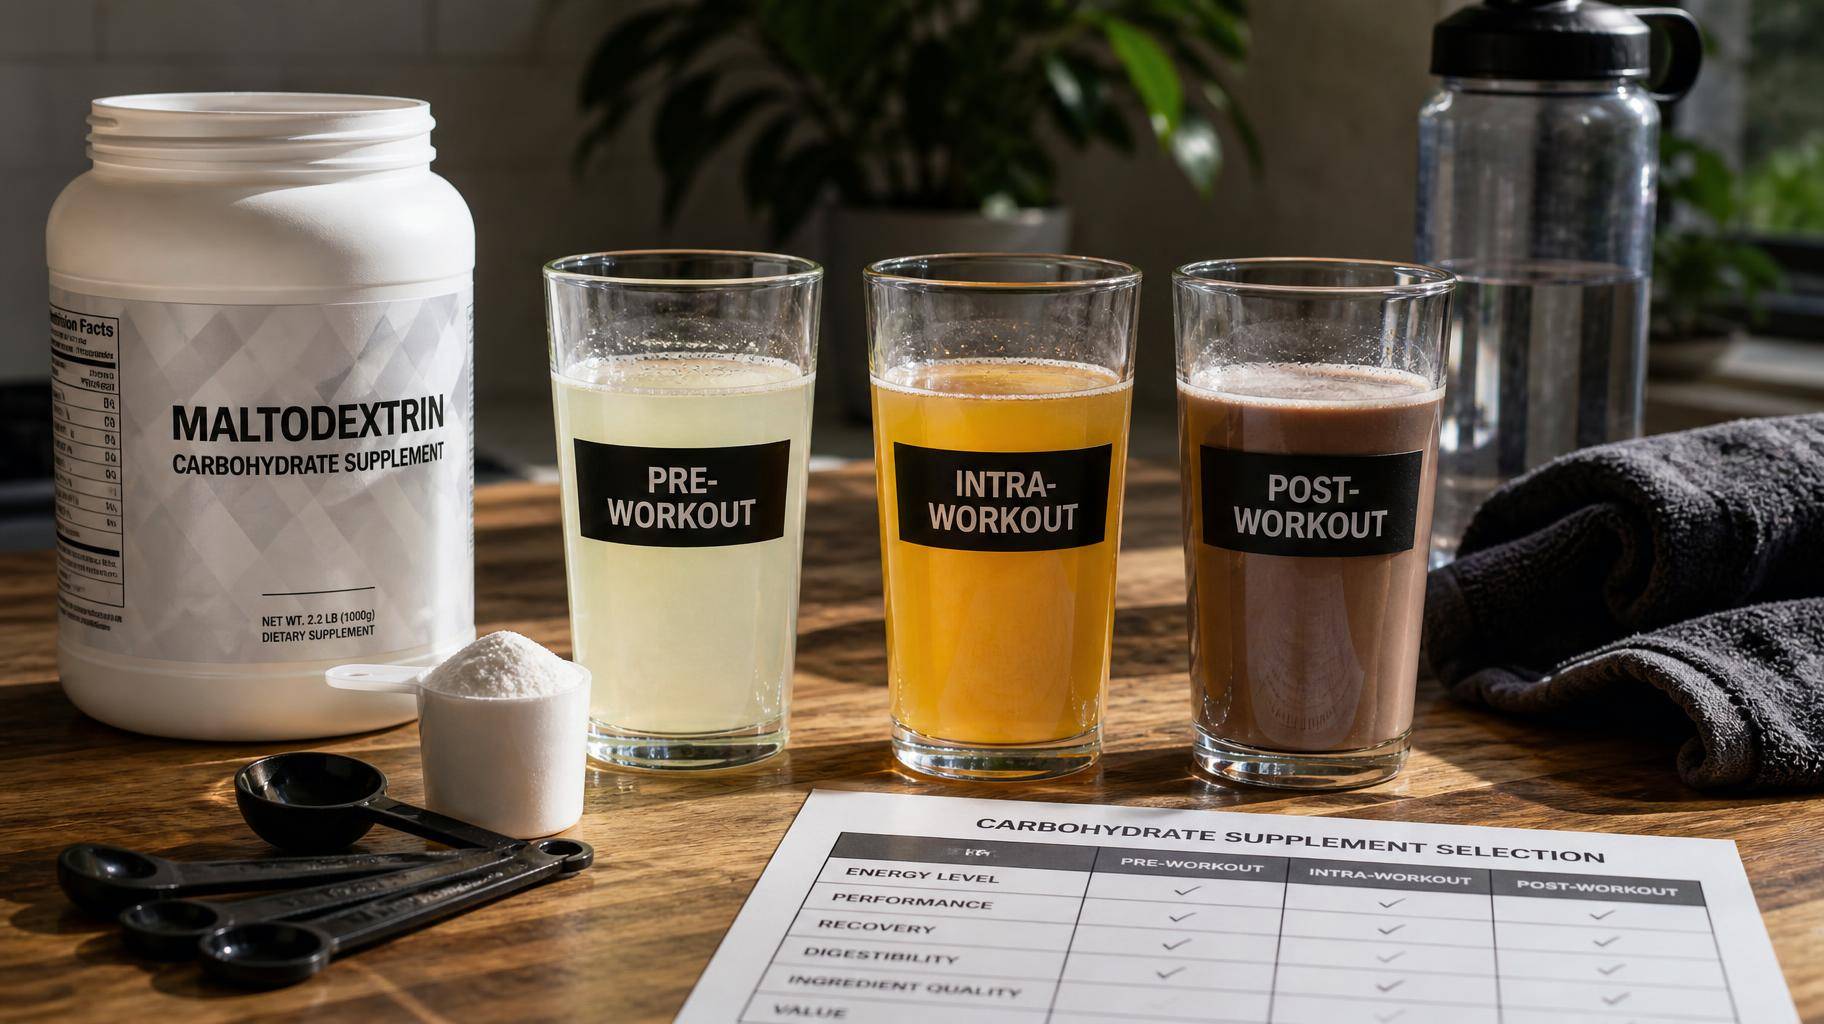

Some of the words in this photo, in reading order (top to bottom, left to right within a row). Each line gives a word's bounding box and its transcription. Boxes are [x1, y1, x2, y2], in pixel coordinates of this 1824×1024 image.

[80, 318, 114, 338] Facts
[172, 393, 444, 442] MALTODEXTRIN
[172, 454, 339, 476] CARBOHYDRATE
[344, 441, 444, 472] SUPPLEMENT
[647, 466, 718, 494] PRE-
[956, 469, 1057, 498] INTRA-
[1268, 474, 1360, 504] POST-
[607, 497, 757, 529] WORKOUT
[928, 502, 1079, 534] WORKOUT
[1233, 506, 1389, 539] WORKOUT
[261, 616, 283, 628] NET
[285, 615, 305, 626] WT.
[307, 613, 323, 626] 2.2
[325, 612, 338, 625] LB
[340, 609, 376, 625] (1000g)
[261, 630, 306, 643] DIETARY
[308, 624, 375, 640] SUPPLEMENT
[976, 817, 1217, 842] CARBOHYDRATE
[1224, 831, 1428, 854] SUPPLEMENT
[1435, 843, 1606, 864] SELECTION
[1120, 857, 1265, 874] PRE-WORKOUT
[845, 867, 932, 881] ENERGY
[937, 873, 1000, 885] LEVEL
[1309, 867, 1472, 886] INTRA-WORKOUT
[1516, 879, 1679, 897] POST-WORKOUT
[831, 892, 995, 911] PERFORMANCE
[817, 918, 936, 936] RECOVERY
[803, 946, 960, 966] DIGESTIBILITY
[787, 974, 920, 993] INGREDIENT
[926, 982, 1022, 998] QUALITY
[773, 1004, 848, 1020] VALUE
